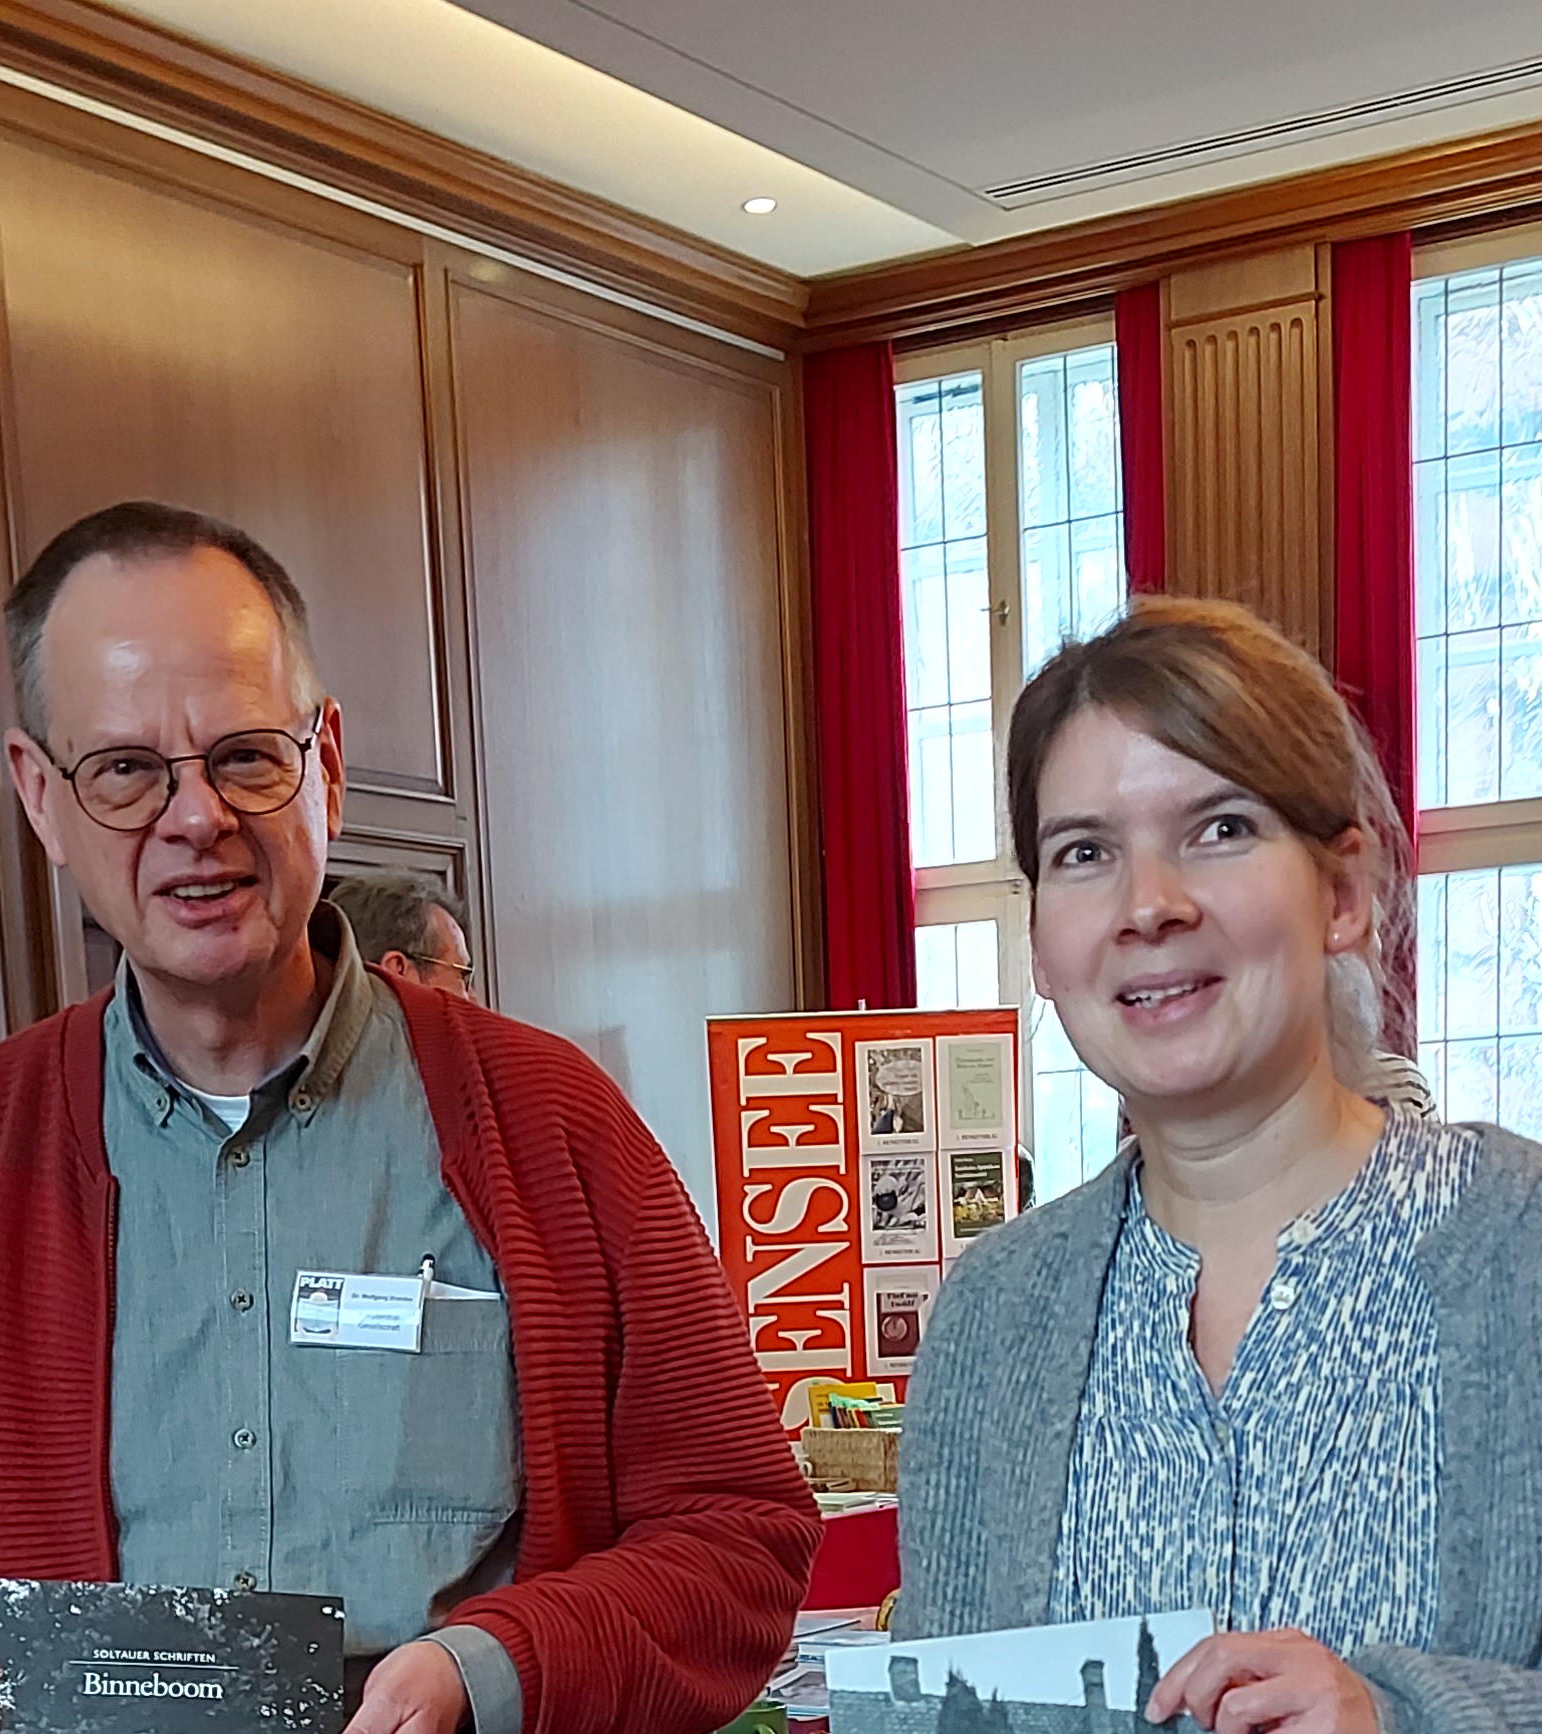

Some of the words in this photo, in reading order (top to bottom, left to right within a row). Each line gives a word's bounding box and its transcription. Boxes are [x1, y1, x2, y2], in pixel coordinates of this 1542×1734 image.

[300, 1276, 343, 1289] PLATT
[93, 1649, 150, 1661] SOLTAUER
[154, 1651, 216, 1663] SCHRIFTEN
[83, 1672, 223, 1699] Binneboom
